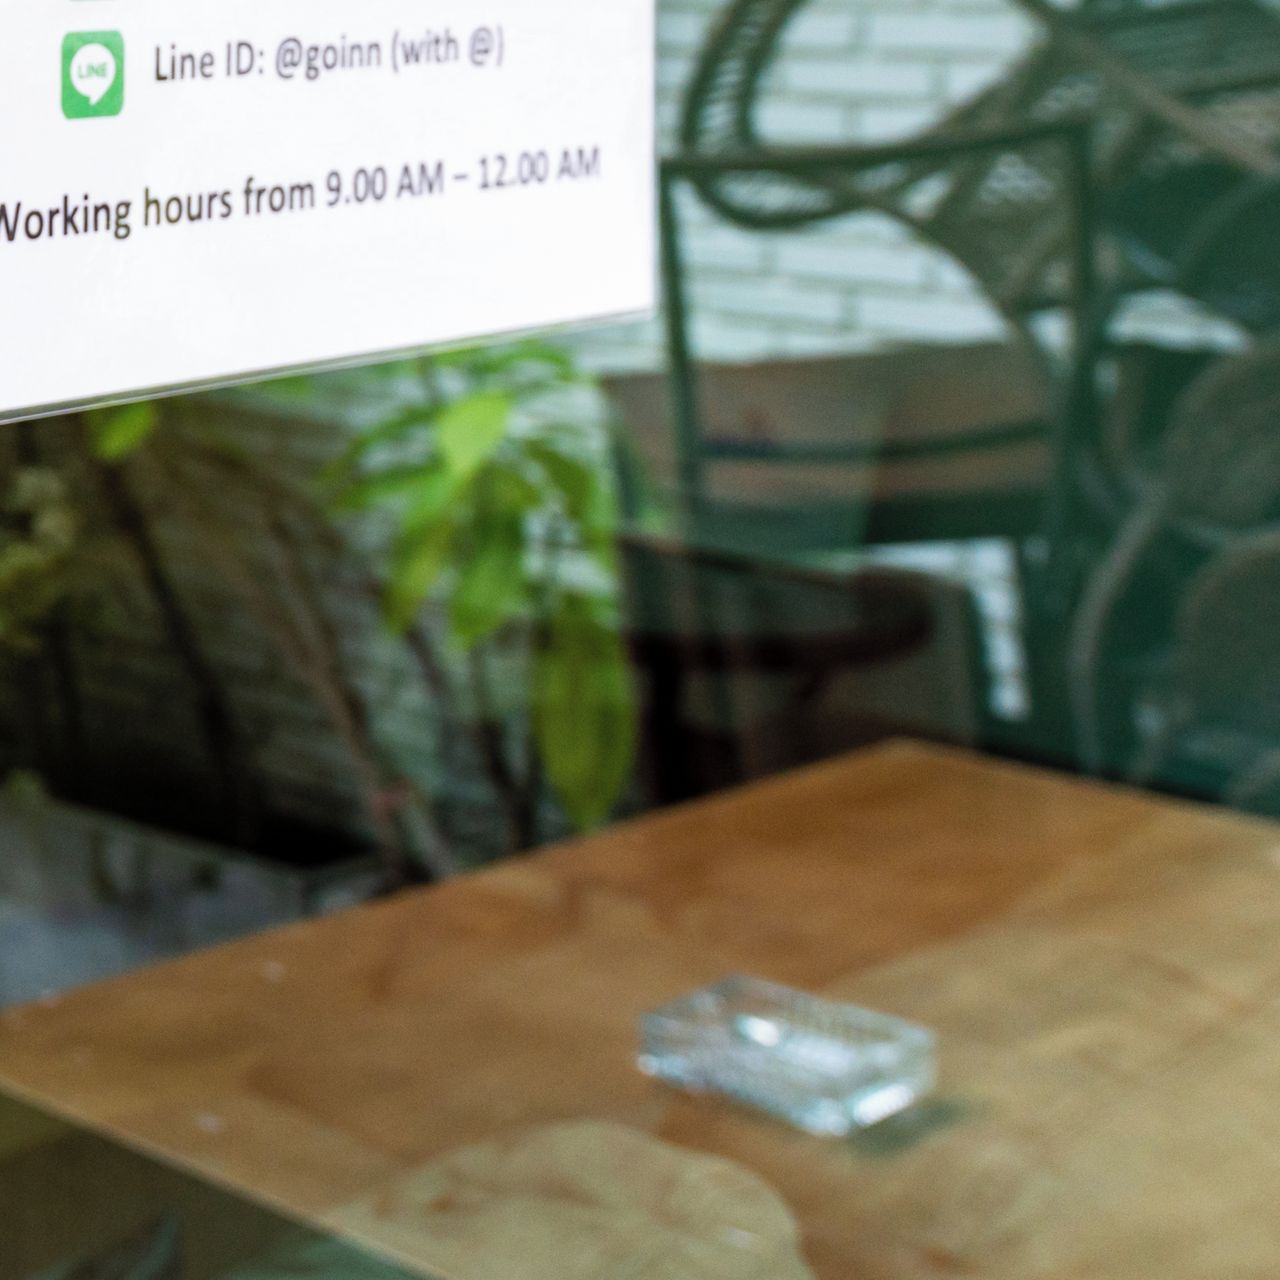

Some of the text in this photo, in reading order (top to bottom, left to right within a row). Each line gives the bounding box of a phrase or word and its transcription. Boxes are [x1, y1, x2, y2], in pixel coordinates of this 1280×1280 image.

[77, 61, 108, 79] LINE
[155, 27, 503, 81] Line ID: @goinn (with @)
[144, 187, 232, 226] hours
[243, 177, 314, 215] from
[326, 166, 387, 207] 9.00
[396, 161, 443, 198] AM
[479, 150, 548, 190] 12.00
[558, 146, 599, 178] AM
